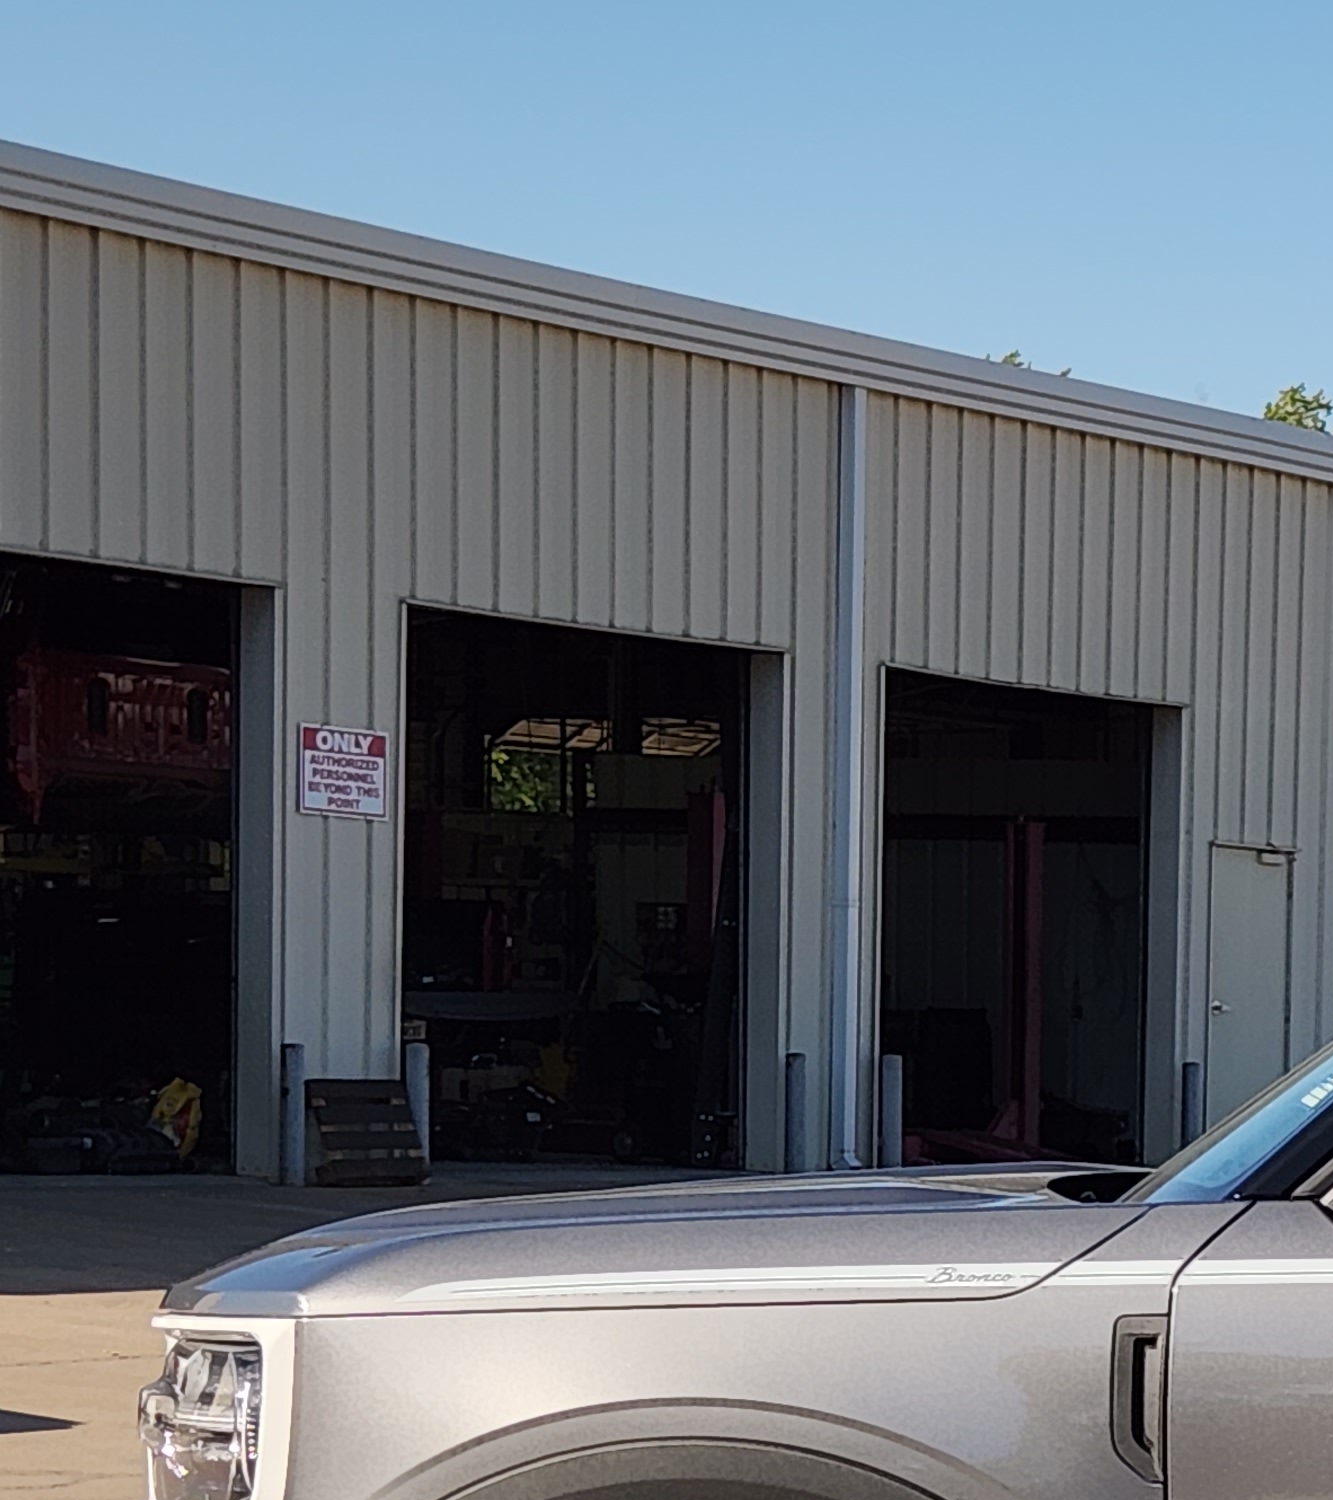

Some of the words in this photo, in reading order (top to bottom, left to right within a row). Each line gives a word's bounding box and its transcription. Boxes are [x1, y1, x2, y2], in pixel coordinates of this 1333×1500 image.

[315, 730, 374, 755] ONLY
[310, 754, 380, 771] AUTHORIZED
[312, 767, 377, 785] PERSONNEL
[308, 781, 352, 796] BEYOND
[355, 786, 380, 799] THIS
[327, 796, 361, 810] POINT
[925, 1266, 1014, 1284] Bronco
